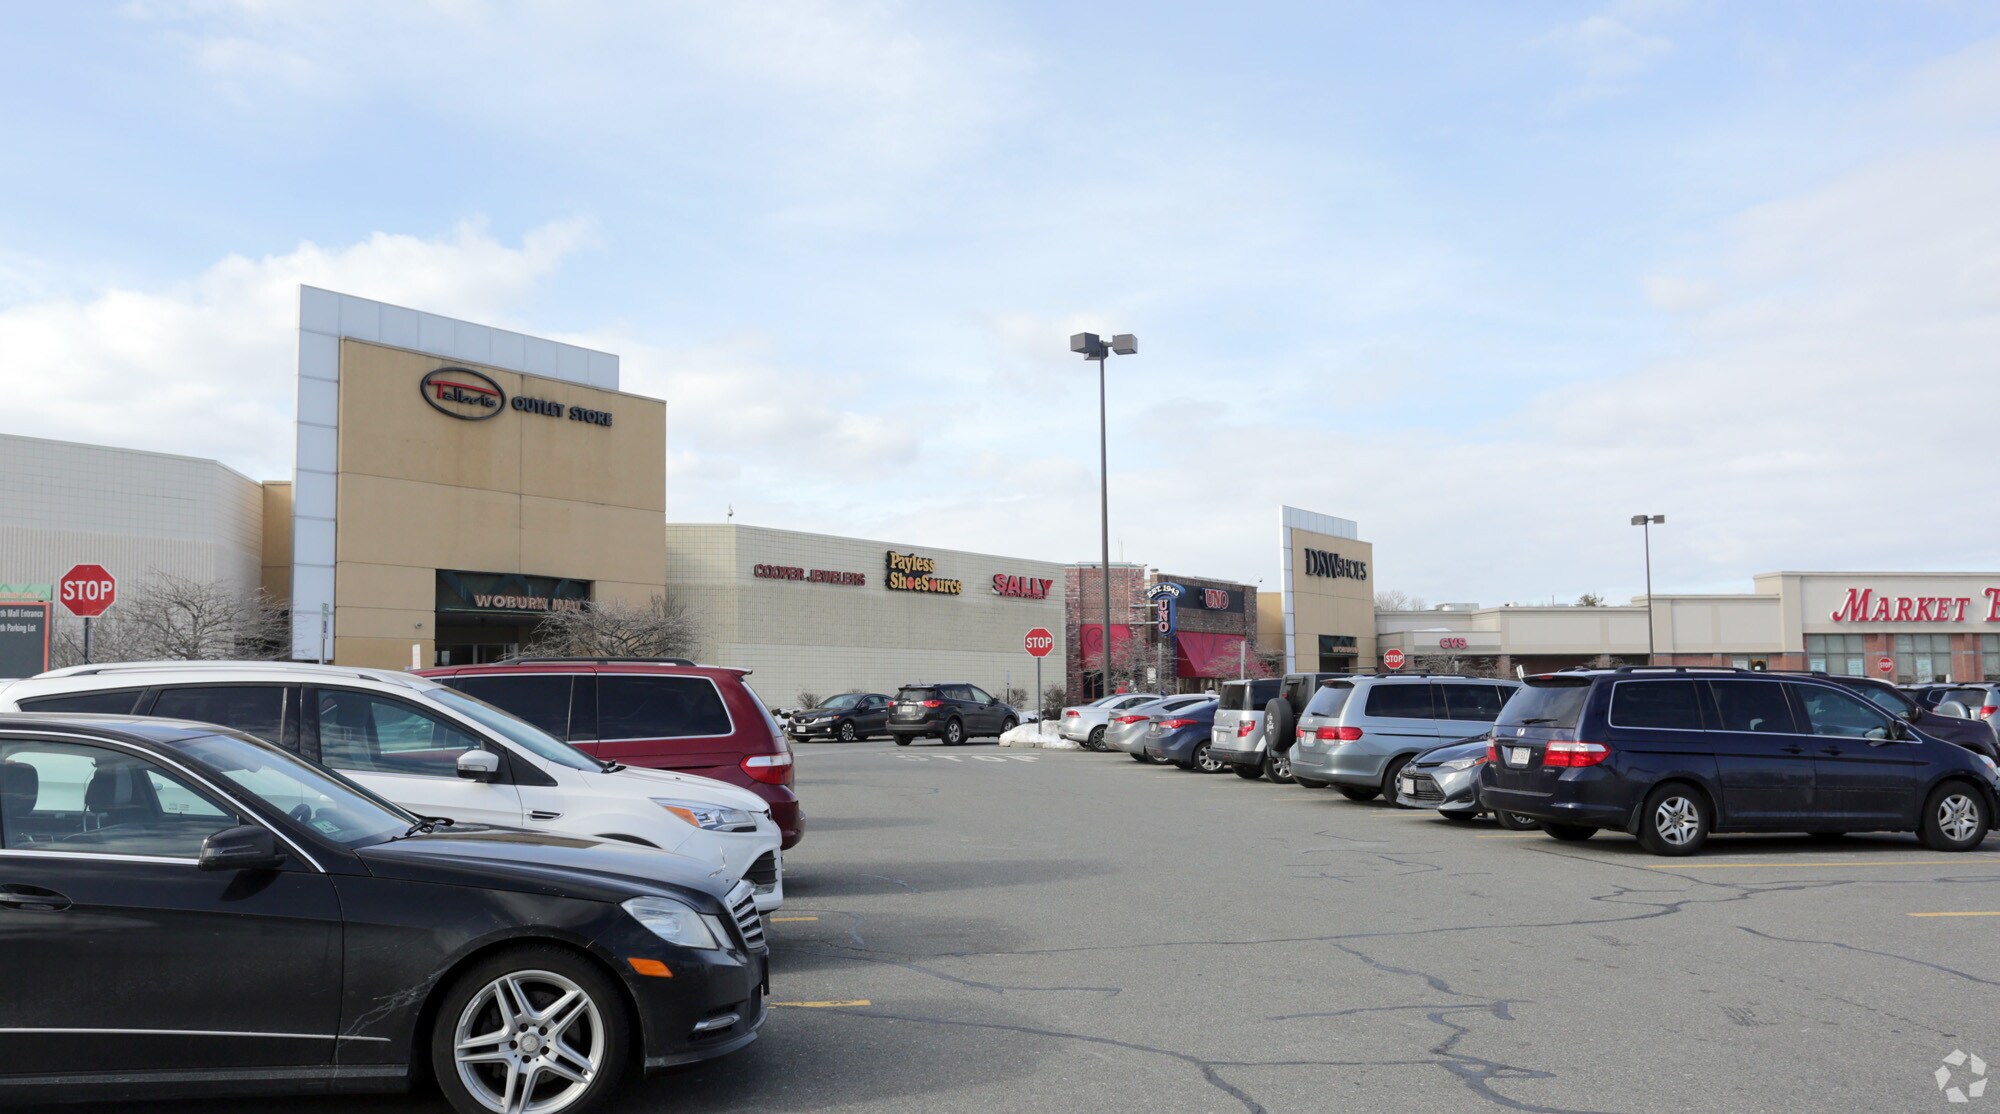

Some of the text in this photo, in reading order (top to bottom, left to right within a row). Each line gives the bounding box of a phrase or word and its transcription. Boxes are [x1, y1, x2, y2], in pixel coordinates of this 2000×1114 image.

[428, 380, 499, 407] Talbots
[511, 396, 613, 427] OUTLET STORE
[890, 551, 935, 574] Payless
[754, 563, 866, 586] COOPER JEWELERS
[890, 571, 963, 595] ShoeSource
[992, 573, 1053, 596] SALLY
[62, 580, 113, 601] STOP
[1163, 584, 1180, 597] 1943
[1204, 588, 1230, 610] UNO
[474, 594, 549, 610] WOBURN
[1829, 588, 1971, 622] MARKET
[7, 609, 20, 618] Mall
[21, 609, 44, 618] Entrance
[1158, 599, 1169, 633] UNO
[7, 623, 27, 634] Parking
[28, 624, 36, 632] Lot
[1026, 636, 1052, 648] STOP
[1439, 637, 1467, 649] CVS
[1385, 654, 1404, 664] STOP
[1879, 661, 1893, 669] STOP
